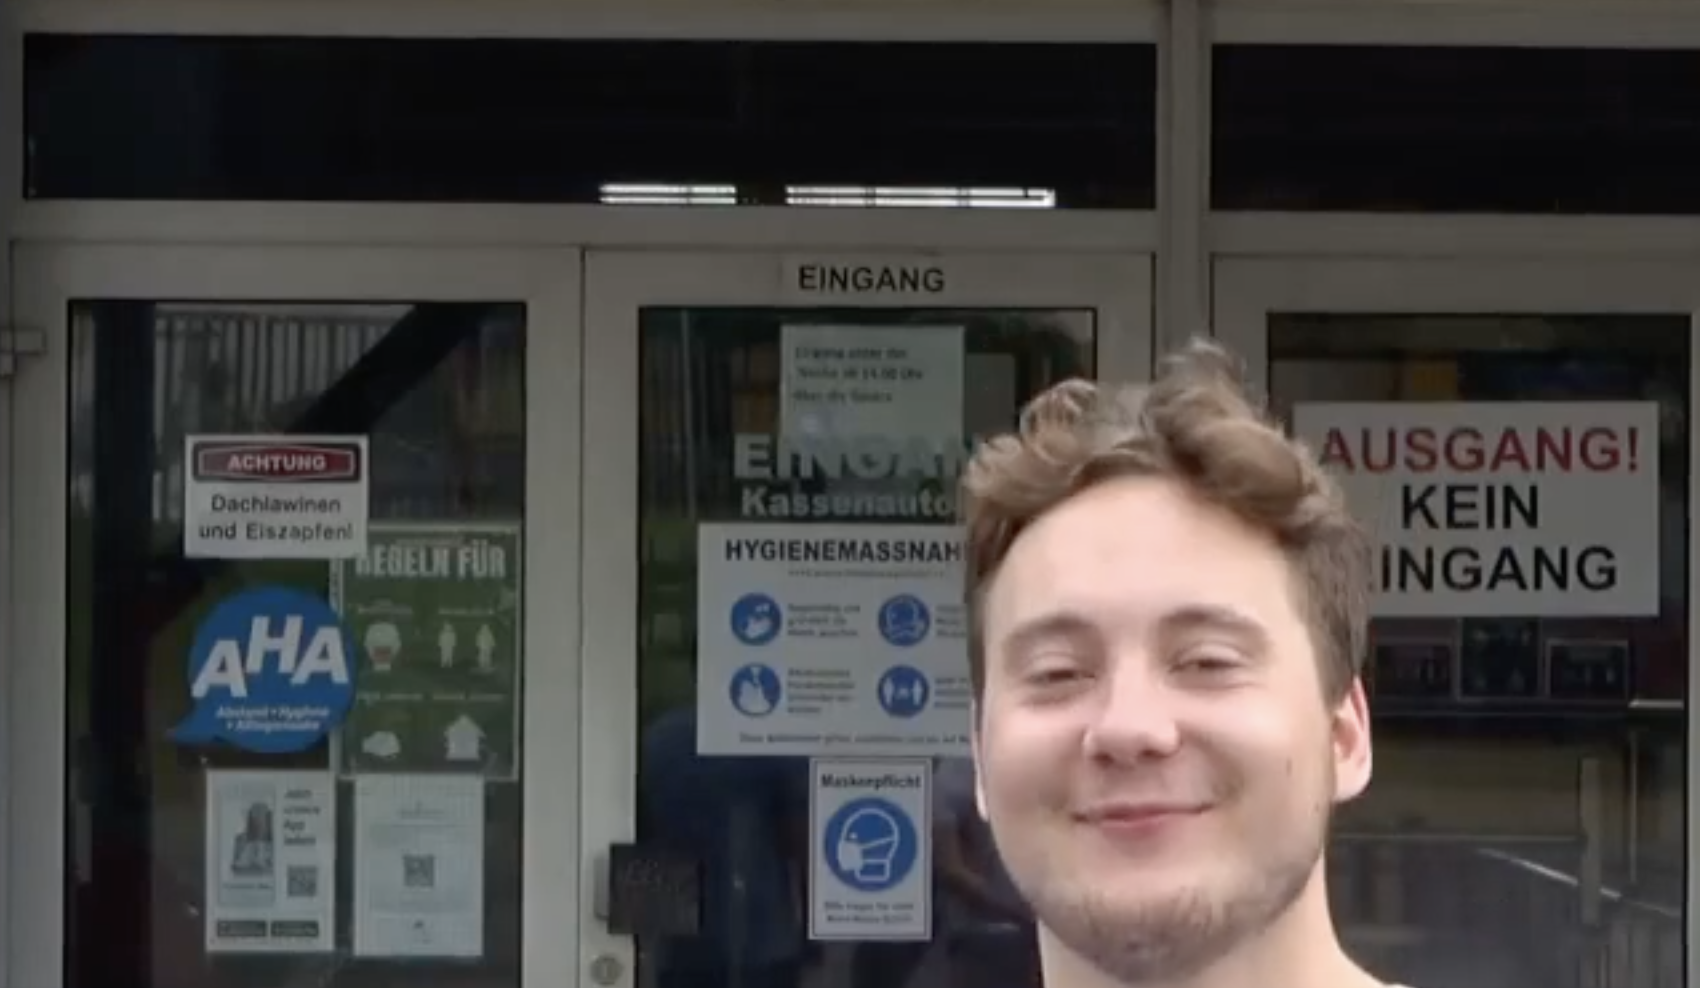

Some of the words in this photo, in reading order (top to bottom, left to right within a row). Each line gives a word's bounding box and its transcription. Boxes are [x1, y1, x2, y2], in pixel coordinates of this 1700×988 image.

[797, 264, 947, 294] EINGANG
[226, 454, 327, 472] ACHTUNG
[1318, 426, 1639, 473] AUSGANG!
[211, 493, 341, 514] Dachlawinen
[741, 486, 964, 518] Kassenauto
[1402, 484, 1540, 530] KEIN
[200, 523, 237, 540] und
[246, 522, 353, 543] Eiszapfen!
[355, 545, 450, 577] REGELN
[457, 539, 507, 578] FÜR
[725, 538, 968, 563] HYGIENEMASSNAH
[1366, 545, 1618, 592] INGANG
[191, 613, 349, 698] AHA
[820, 773, 922, 791] Maskenpflicht
